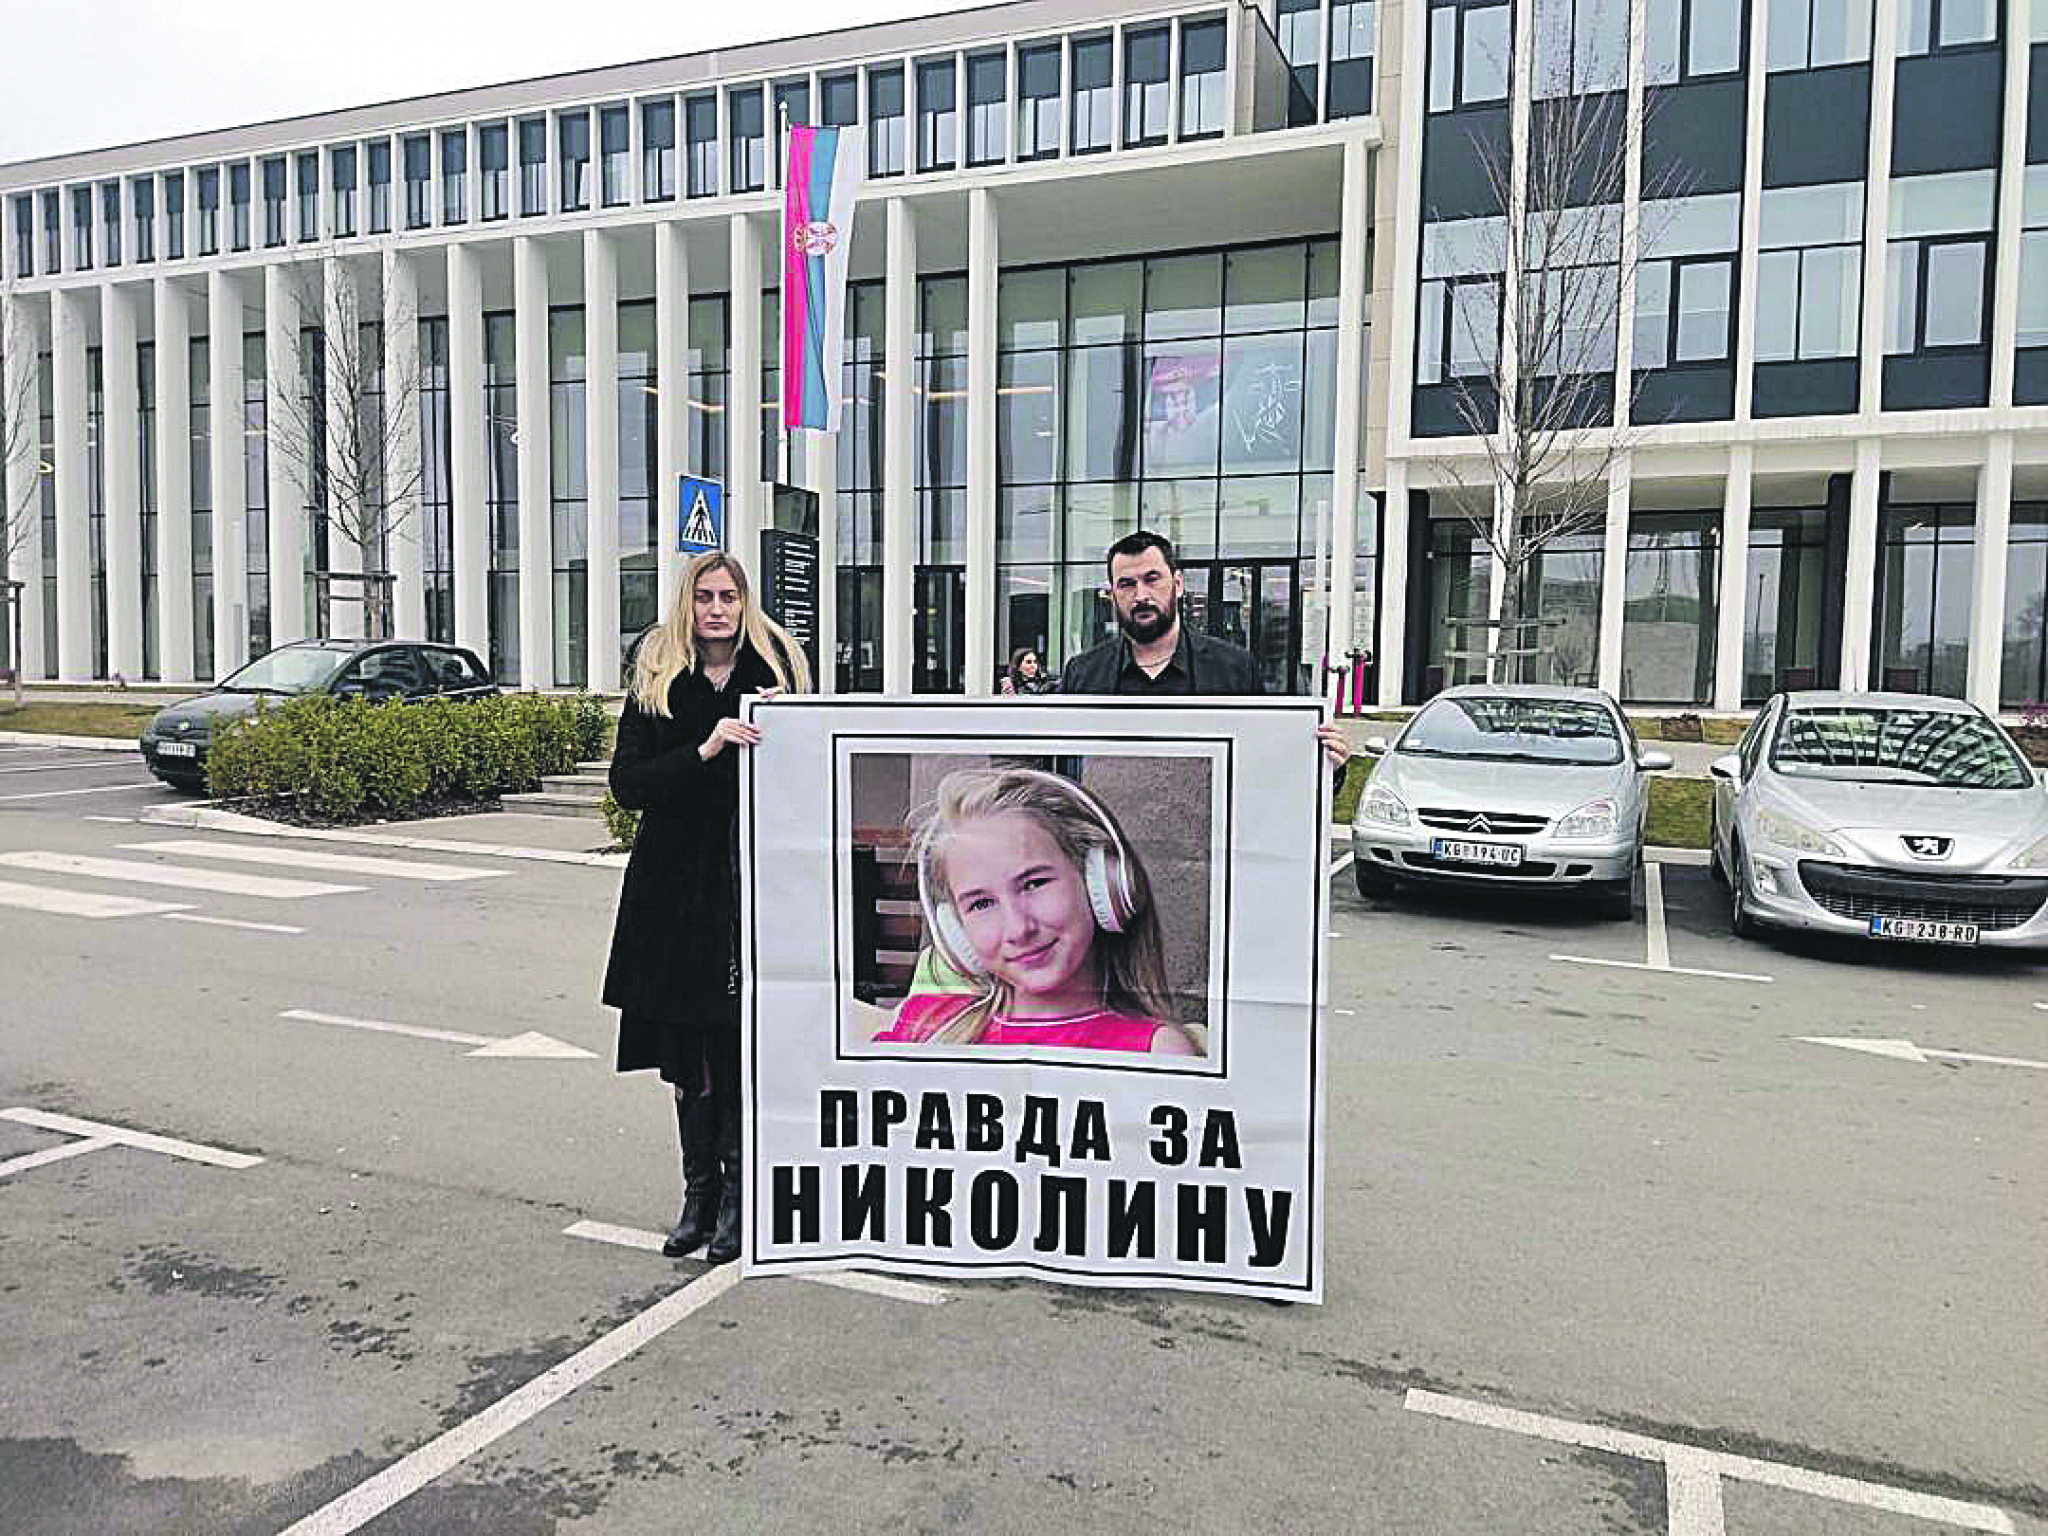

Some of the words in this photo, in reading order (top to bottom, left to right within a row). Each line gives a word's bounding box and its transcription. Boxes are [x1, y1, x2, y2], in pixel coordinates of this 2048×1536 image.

[820, 1090, 1111, 1168] ПРАВДА
[1150, 1105, 1242, 1169] ЗА
[772, 1163, 1293, 1268] НИКОЛИНУ
